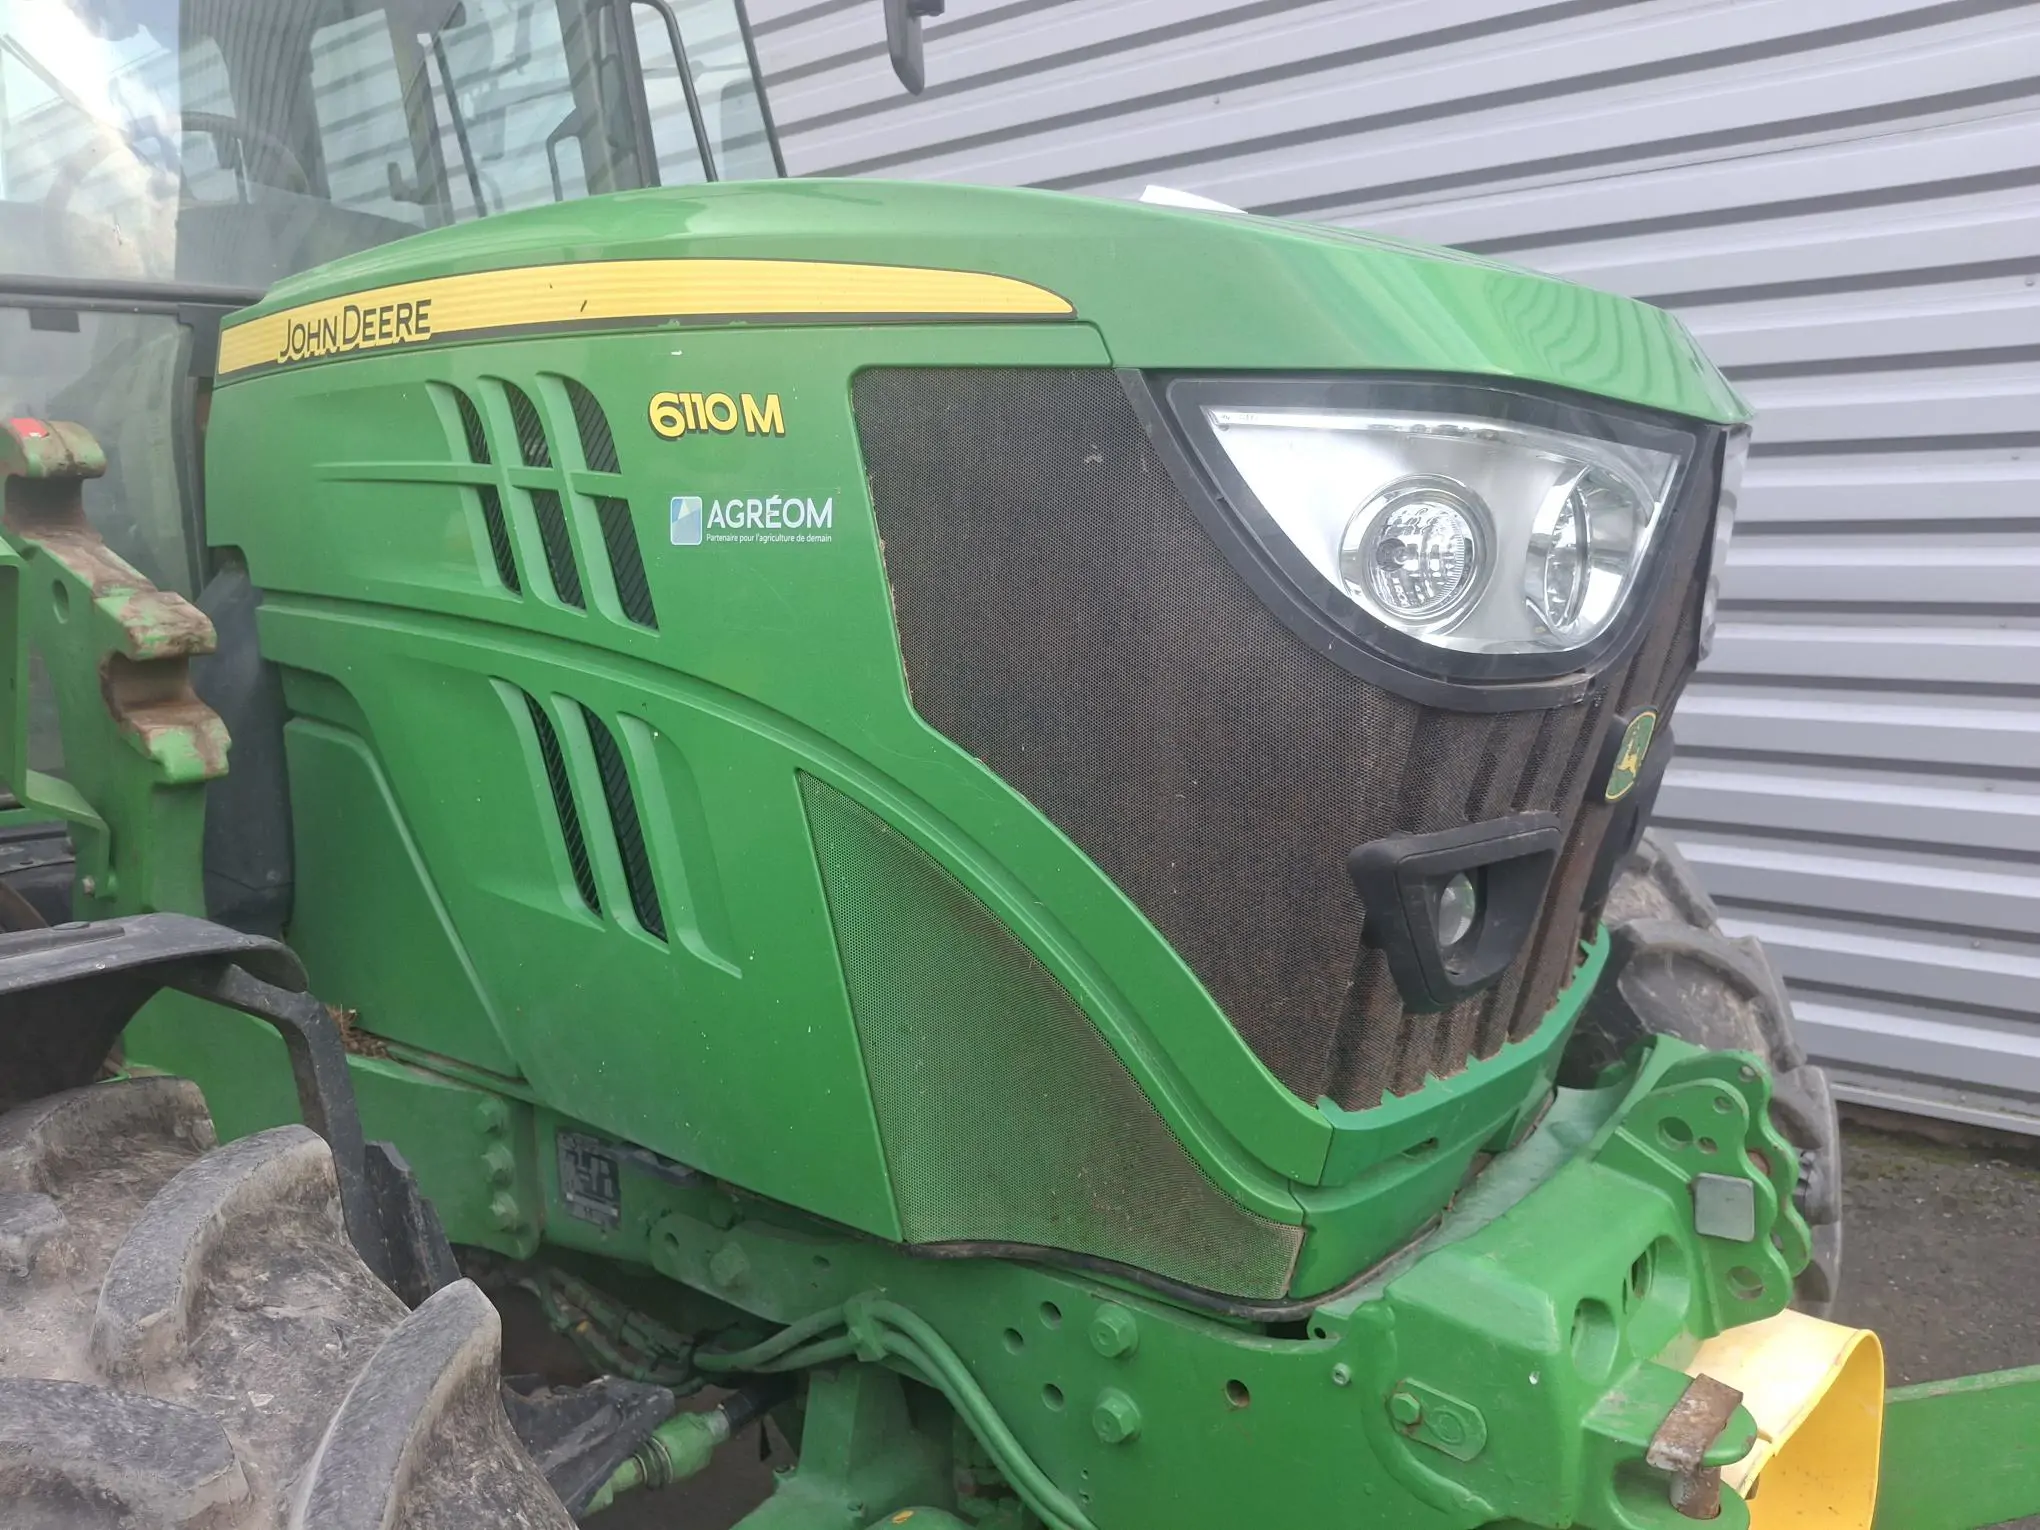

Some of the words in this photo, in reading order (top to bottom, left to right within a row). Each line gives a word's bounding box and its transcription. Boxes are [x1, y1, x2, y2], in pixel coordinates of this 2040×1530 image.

[278, 315, 338, 358] JOHN
[342, 299, 432, 346] DEERE
[649, 391, 739, 440] 6110
[741, 393, 786, 437] M
[706, 495, 833, 529] AGRÉOM
[706, 533, 738, 542] Partenaire
[739, 535, 754, 543] pour
[796, 533, 806, 542] de
[806, 533, 832, 542] demain
